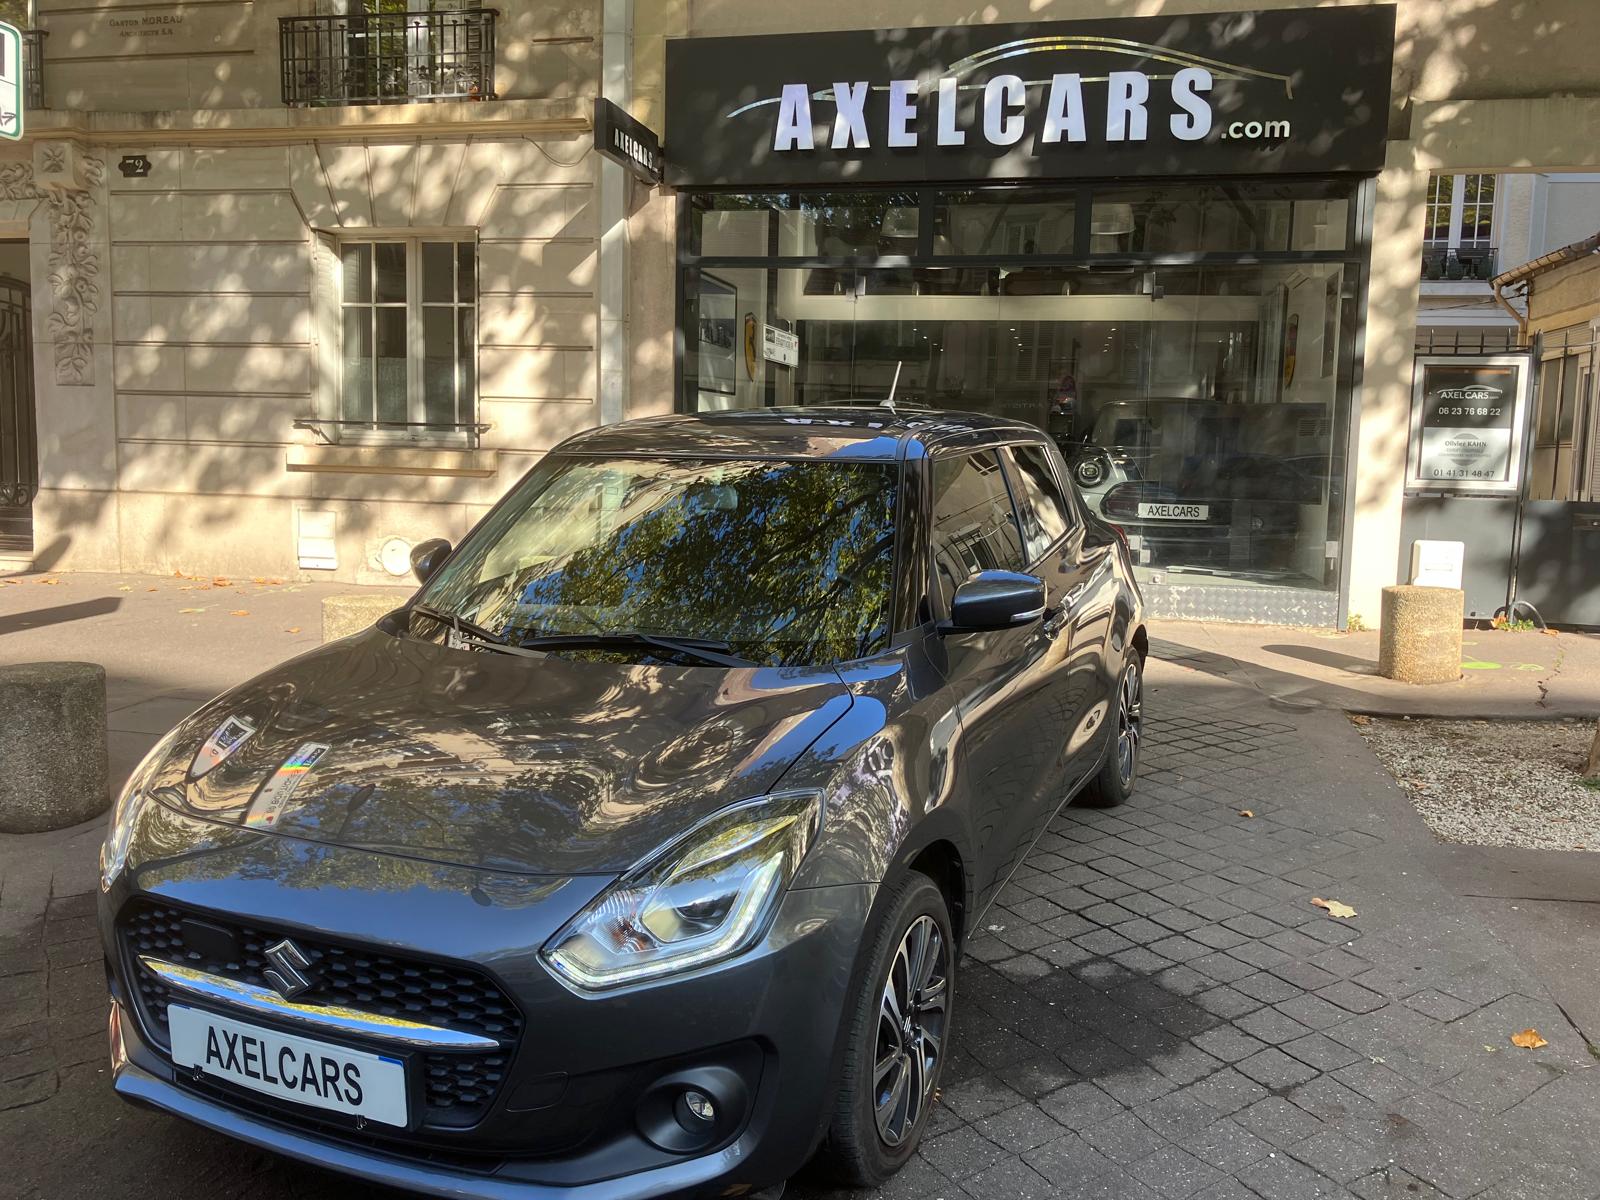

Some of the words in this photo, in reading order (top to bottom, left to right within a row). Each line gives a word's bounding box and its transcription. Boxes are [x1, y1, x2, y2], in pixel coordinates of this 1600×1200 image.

[142, 15, 183, 25] MOREAU
[773, 67, 1213, 150] AXELCARS
[1220, 117, 1291, 142] .com
[614, 127, 653, 169] AXELCARS
[1440, 391, 1489, 400] AXELCARS
[1439, 407, 1449, 415] 06
[1451, 407, 1462, 415] 23
[1476, 407, 1488, 415] 68
[1433, 469, 1443, 477] 01
[1446, 469, 1456, 477] 41
[1484, 470, 1495, 478] 47
[1147, 505, 1200, 518] AXELCARS
[206, 1025, 363, 1106] AXELCARS
